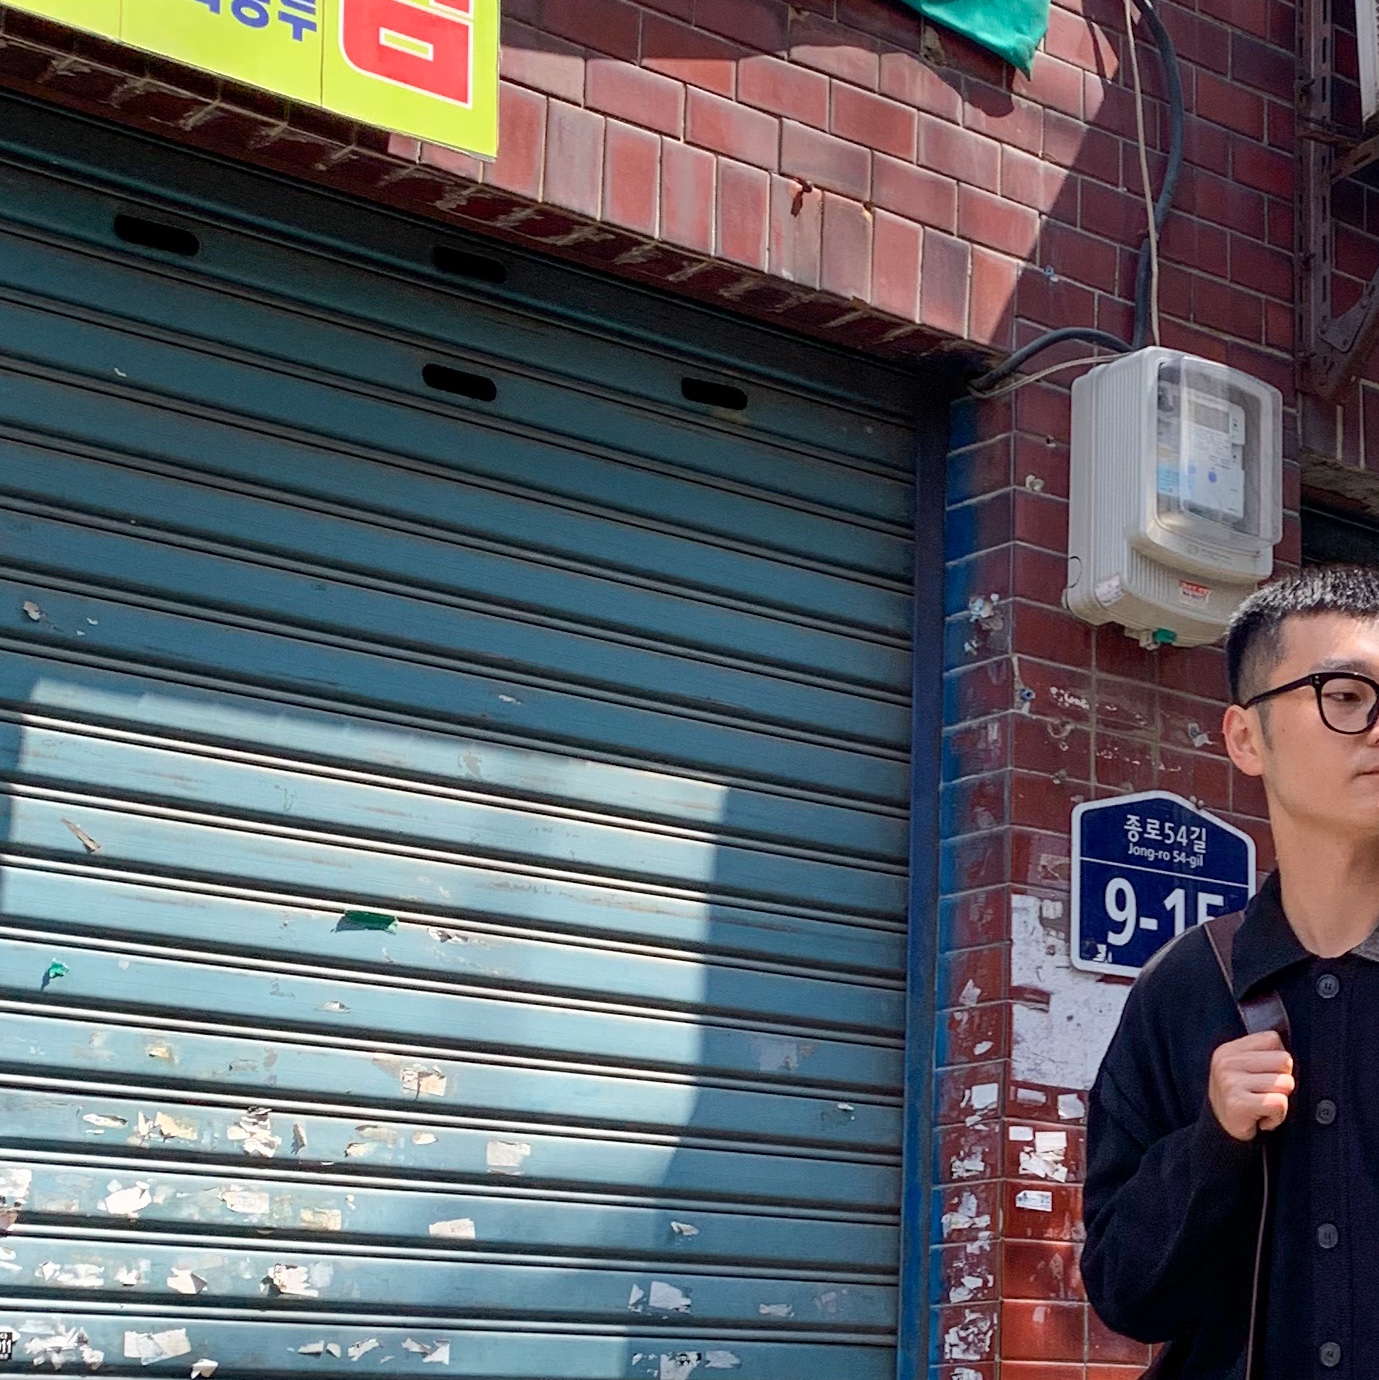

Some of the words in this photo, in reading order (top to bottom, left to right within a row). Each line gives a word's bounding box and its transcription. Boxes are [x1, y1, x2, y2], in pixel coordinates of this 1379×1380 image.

[1123, 814, 1207, 853] 종로54길
[1127, 843, 1170, 861] Jong-ro
[1172, 851, 1204, 868] 54-gil
